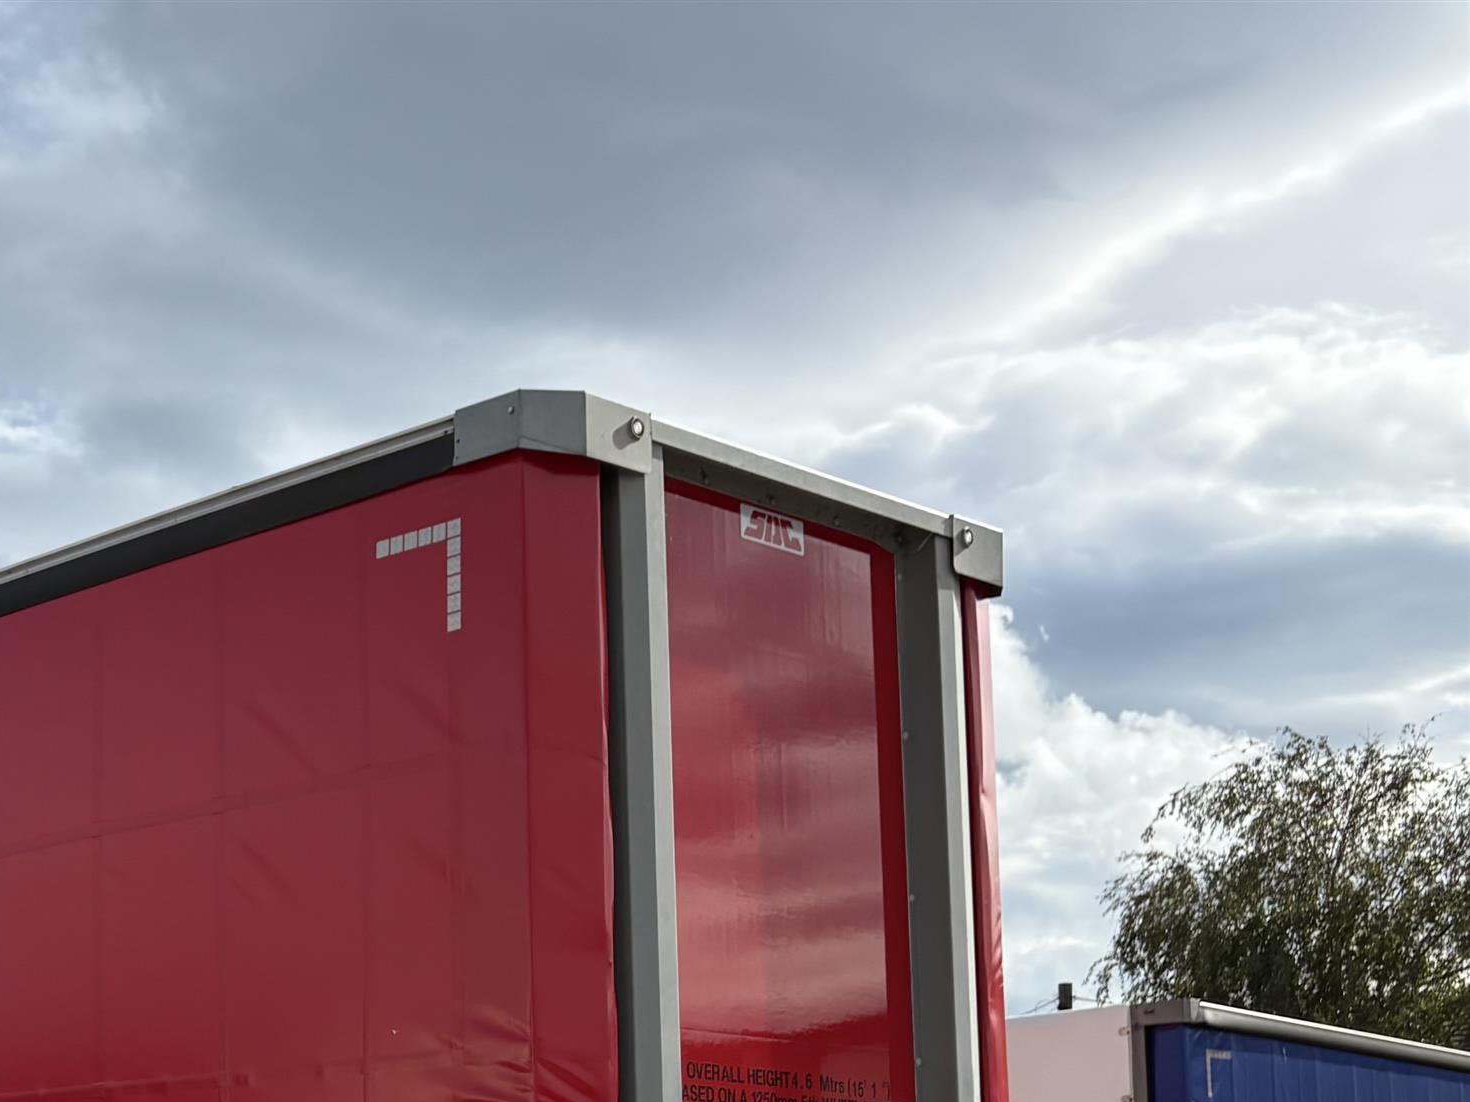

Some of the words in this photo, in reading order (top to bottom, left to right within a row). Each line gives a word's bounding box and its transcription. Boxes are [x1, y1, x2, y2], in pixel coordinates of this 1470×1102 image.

[686, 1061, 745, 1084] OVERALL
[747, 1068, 790, 1088] HEIGHT
[820, 1074, 845, 1093] Mtrs
[682, 1085, 714, 1102] ASED
